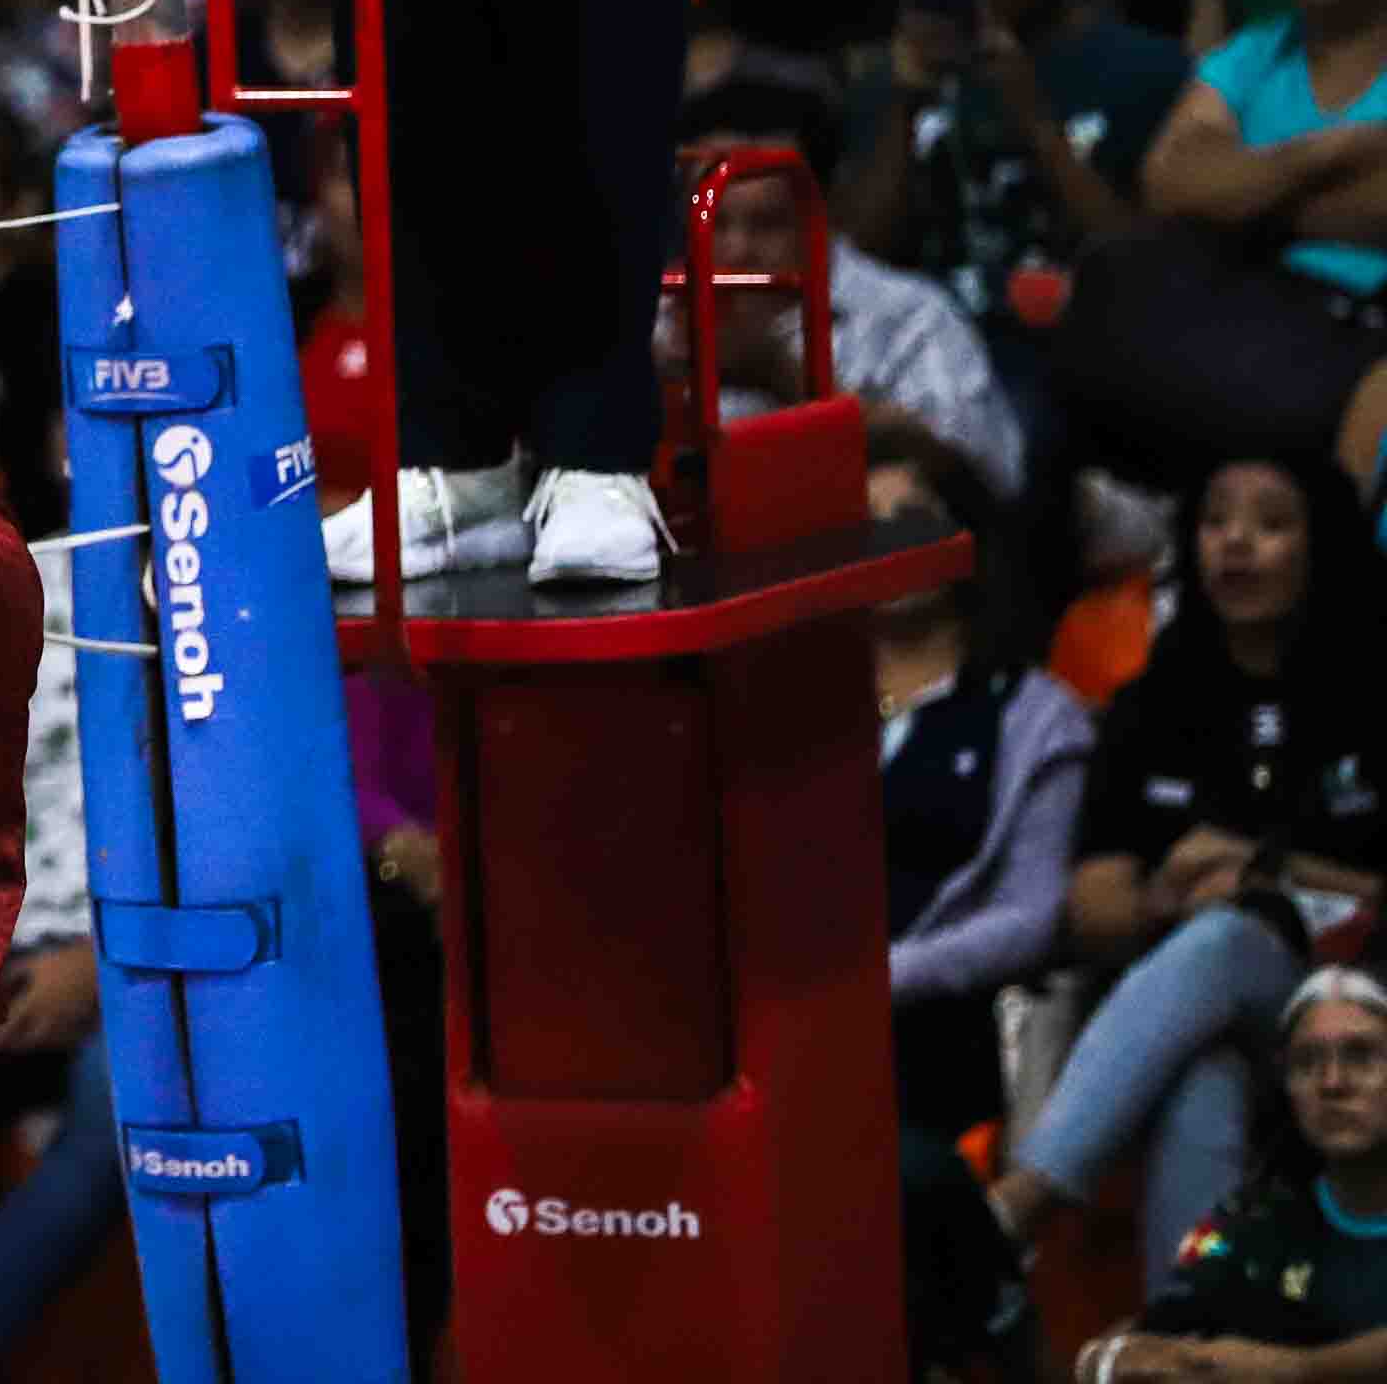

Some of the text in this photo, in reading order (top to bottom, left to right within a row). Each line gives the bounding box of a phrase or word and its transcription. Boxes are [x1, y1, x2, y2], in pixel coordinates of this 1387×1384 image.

[95, 359, 170, 390] FIVB
[161, 489, 224, 722] Senoh
[144, 1152, 250, 1179] Senoh
[534, 1197, 701, 1238] Senoh
